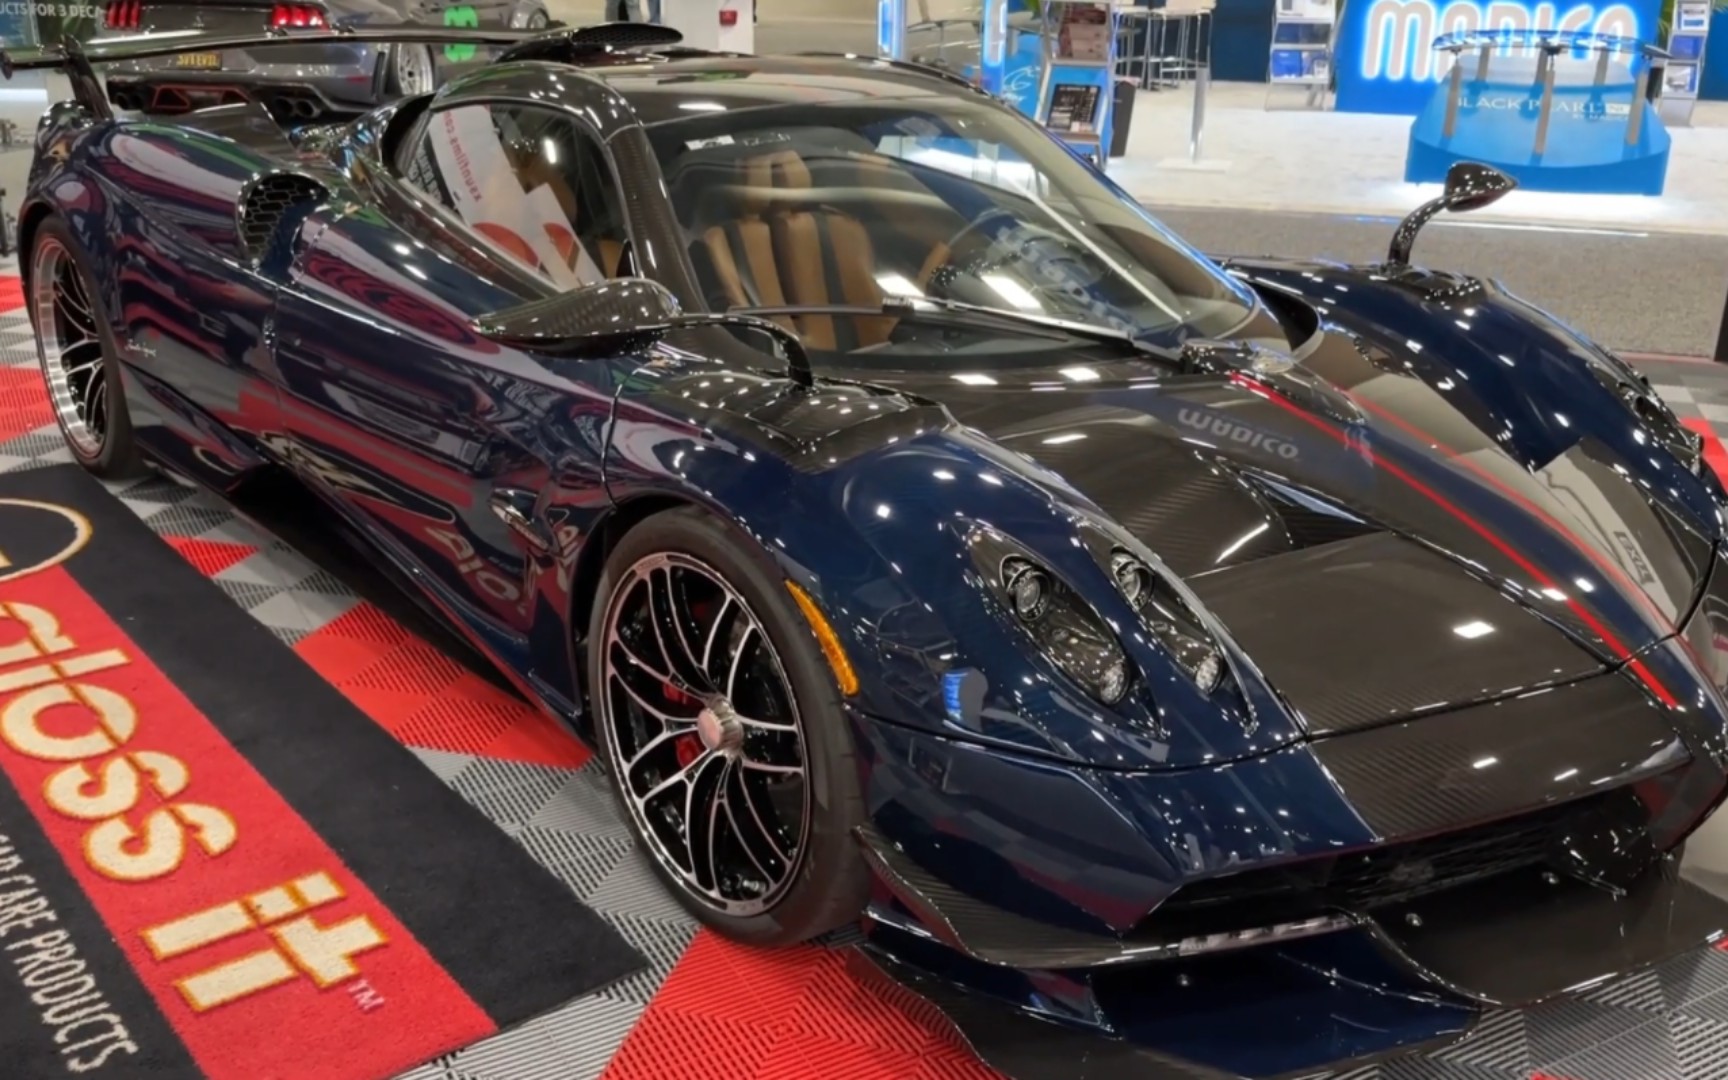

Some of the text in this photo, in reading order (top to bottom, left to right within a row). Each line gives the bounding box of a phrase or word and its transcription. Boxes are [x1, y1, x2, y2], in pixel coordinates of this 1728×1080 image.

[32, 4, 56, 17] FOR
[58, 5, 67, 17] 3
[4, 929, 139, 1073] PRODUCTS
